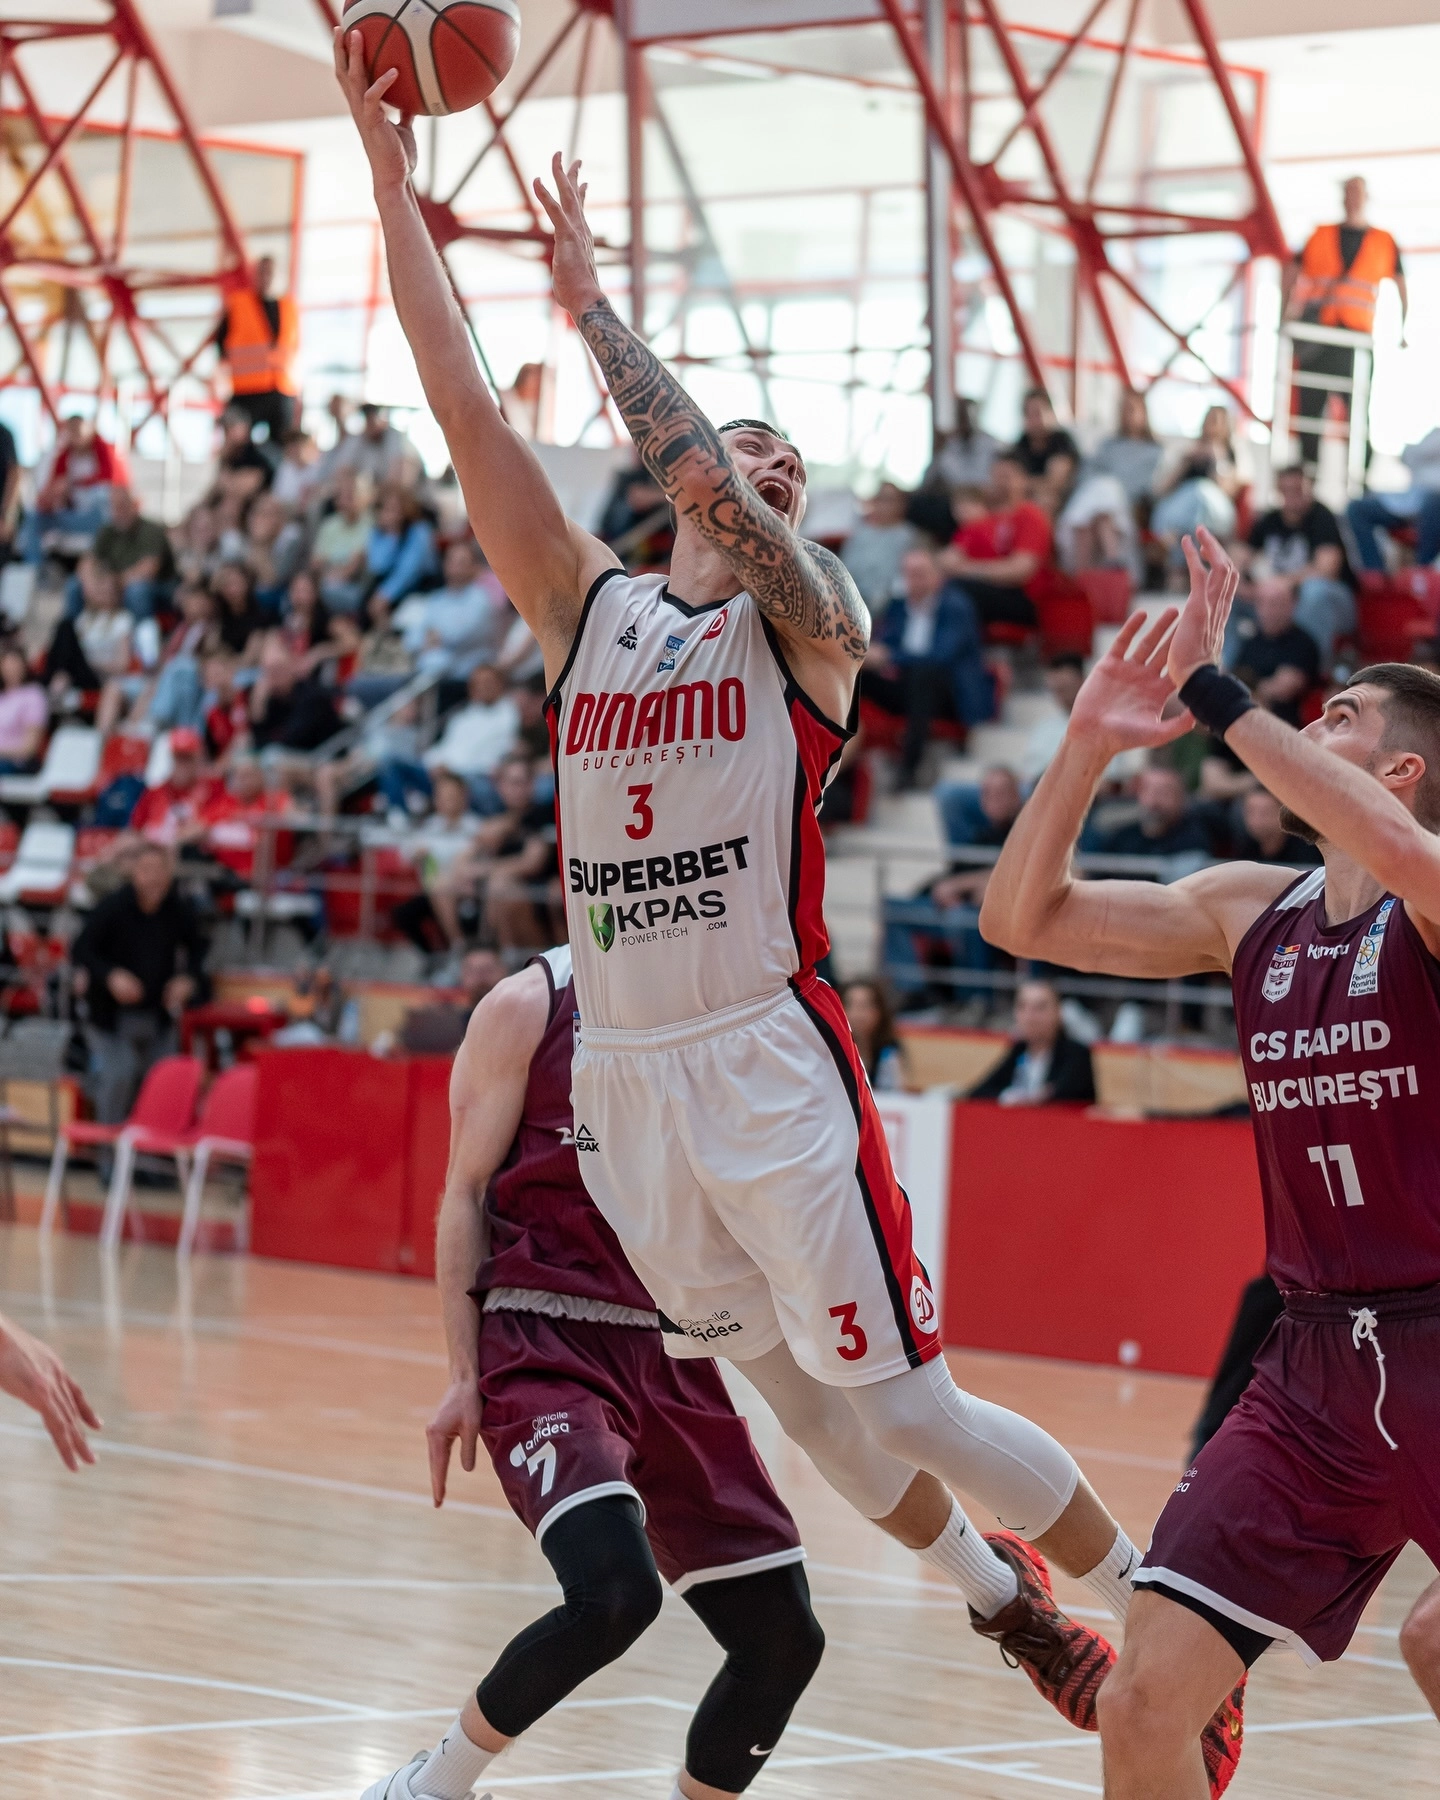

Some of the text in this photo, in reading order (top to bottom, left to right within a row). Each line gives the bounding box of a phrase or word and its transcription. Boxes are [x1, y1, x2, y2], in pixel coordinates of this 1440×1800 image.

[565, 677, 746, 755] DINAMO
[582, 745, 713, 771] BUCUREȘTI
[625, 782, 654, 840] 3
[569, 835, 750, 896] SUPERBET
[616, 890, 726, 932] KPAS
[621, 927, 688, 946] POWER TECH
[706, 921, 728, 931] .COM
[1250, 1020, 1391, 1063] CS RAPID
[1307, 1144, 1365, 1207] 11
[828, 1301, 868, 1361] 3
[526, 1440, 557, 1497] 7
